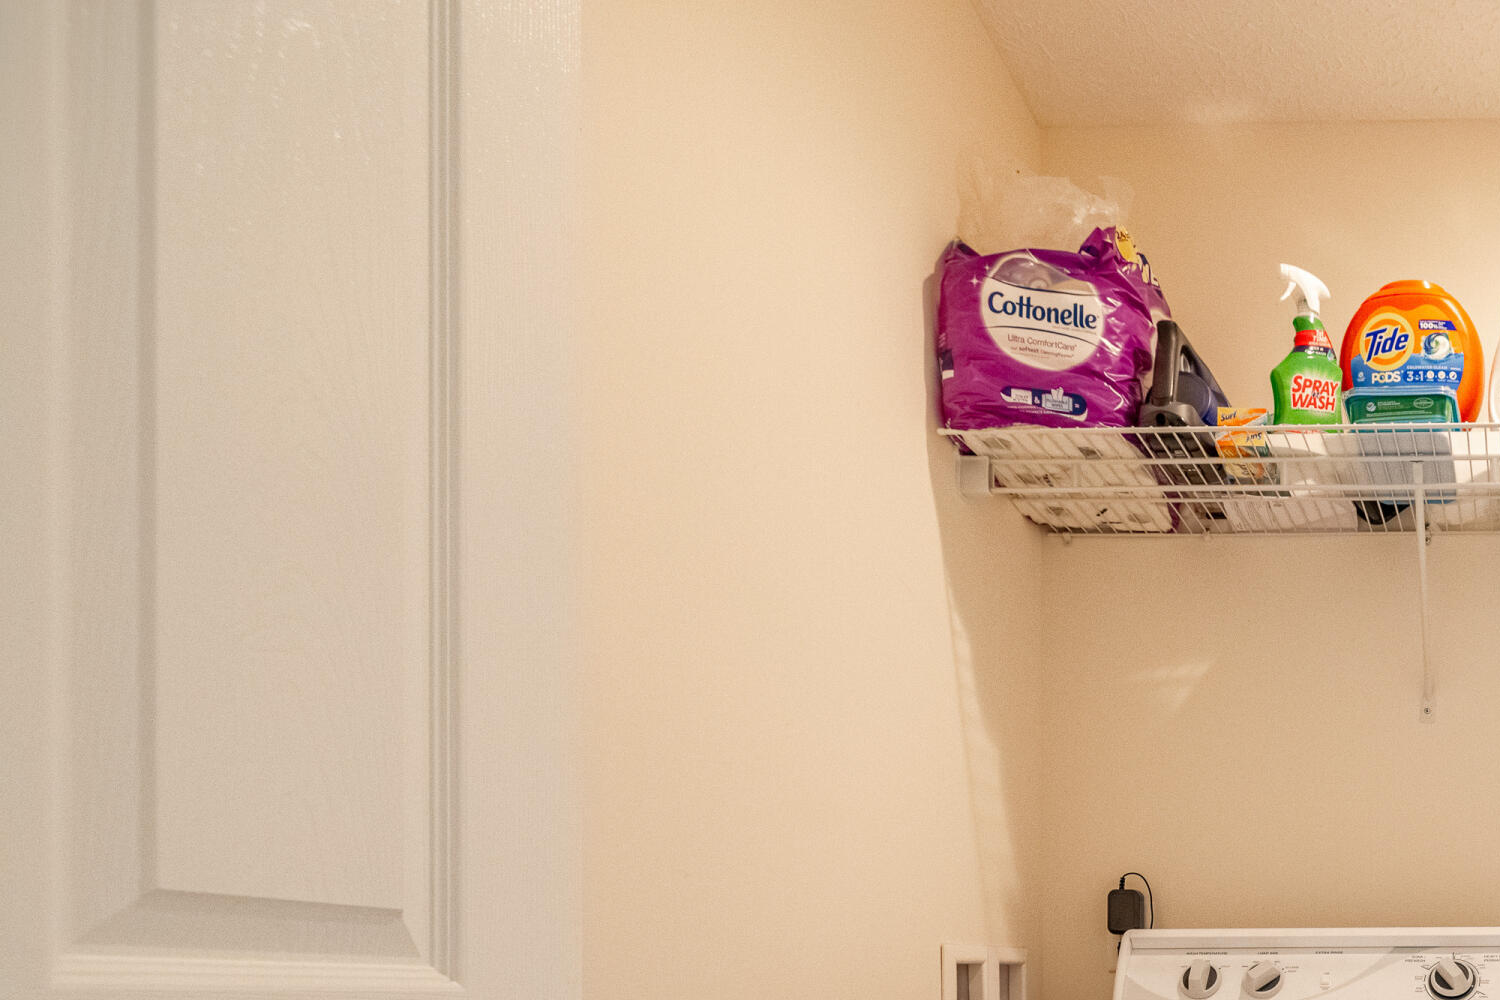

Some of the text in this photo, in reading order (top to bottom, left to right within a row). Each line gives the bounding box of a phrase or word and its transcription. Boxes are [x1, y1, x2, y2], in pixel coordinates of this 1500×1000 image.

[988, 291, 1097, 329] Cottonelle
[1008, 333, 1025, 345] Ultra
[1365, 327, 1409, 362] Tide
[1292, 375, 1338, 397] SPRAY
[1371, 371, 1401, 384] PODS
[1292, 393, 1335, 411] WASH
